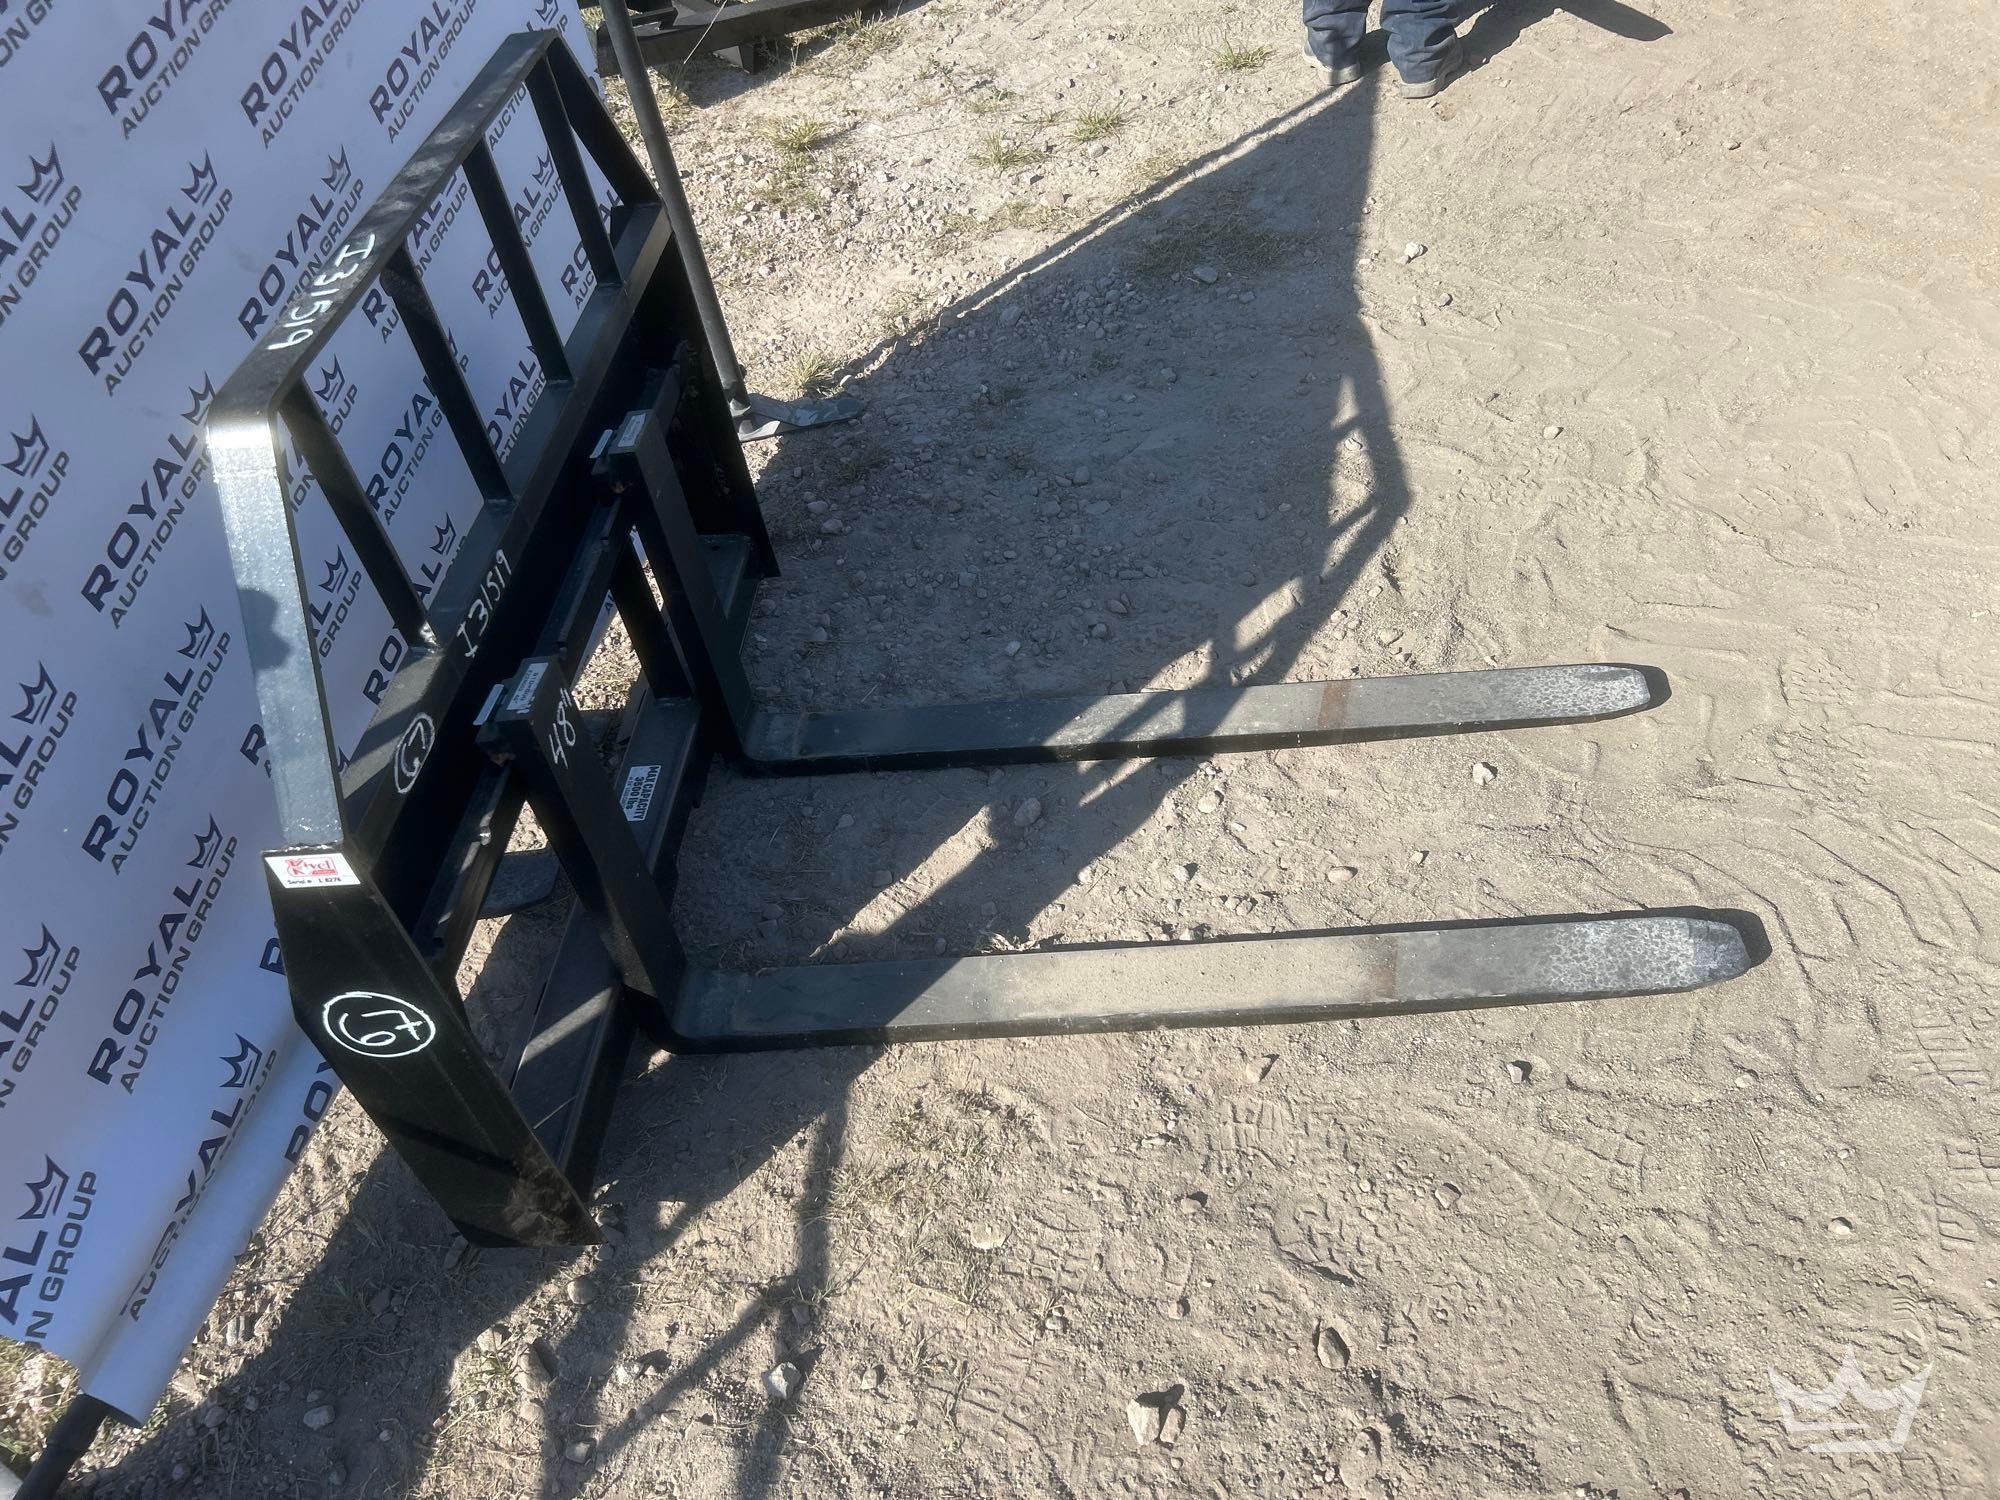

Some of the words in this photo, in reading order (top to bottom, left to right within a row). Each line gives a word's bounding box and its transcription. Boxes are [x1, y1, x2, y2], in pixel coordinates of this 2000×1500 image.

[119, 28, 200, 140] AUCTION
[261, 48, 325, 149] AUCTION
[321, 0, 365, 55] GROU
[368, 1, 450, 125] ROYAL
[387, 56, 440, 144] AUCTION
[438, 0, 476, 62] GROUP
[489, 86, 527, 151] AUCTIO
[17, 186, 82, 288] GROUP
[238, 193, 335, 341] ROYAL
[319, 178, 364, 256] GROUP
[430, 182, 468, 252] GROUP
[78, 206, 196, 376] ROYAL
[105, 274, 184, 397] AUCTION
[180, 188, 233, 278] GROUP
[330, 384, 358, 435] OUP
[4, 451, 70, 561] GROUP
[81, 434, 198, 613] ROYAL
[384, 427, 434, 525] AUCTION
[110, 498, 185, 629] AUCTION
[319, 571, 362, 658] GROUP
[13, 691, 78, 810] GROUP
[82, 668, 194, 863] ROYAL
[111, 735, 182, 876] AUCTION
[178, 632, 231, 733] GROUP
[633, 783, 654, 819] CAPACITY
[11, 946, 80, 1073] GROUP
[87, 879, 202, 1085] ROYAL
[120, 946, 191, 1095] AUCTION
[186, 836, 238, 943] GROUP
[39, 1171, 97, 1302] GROUP
